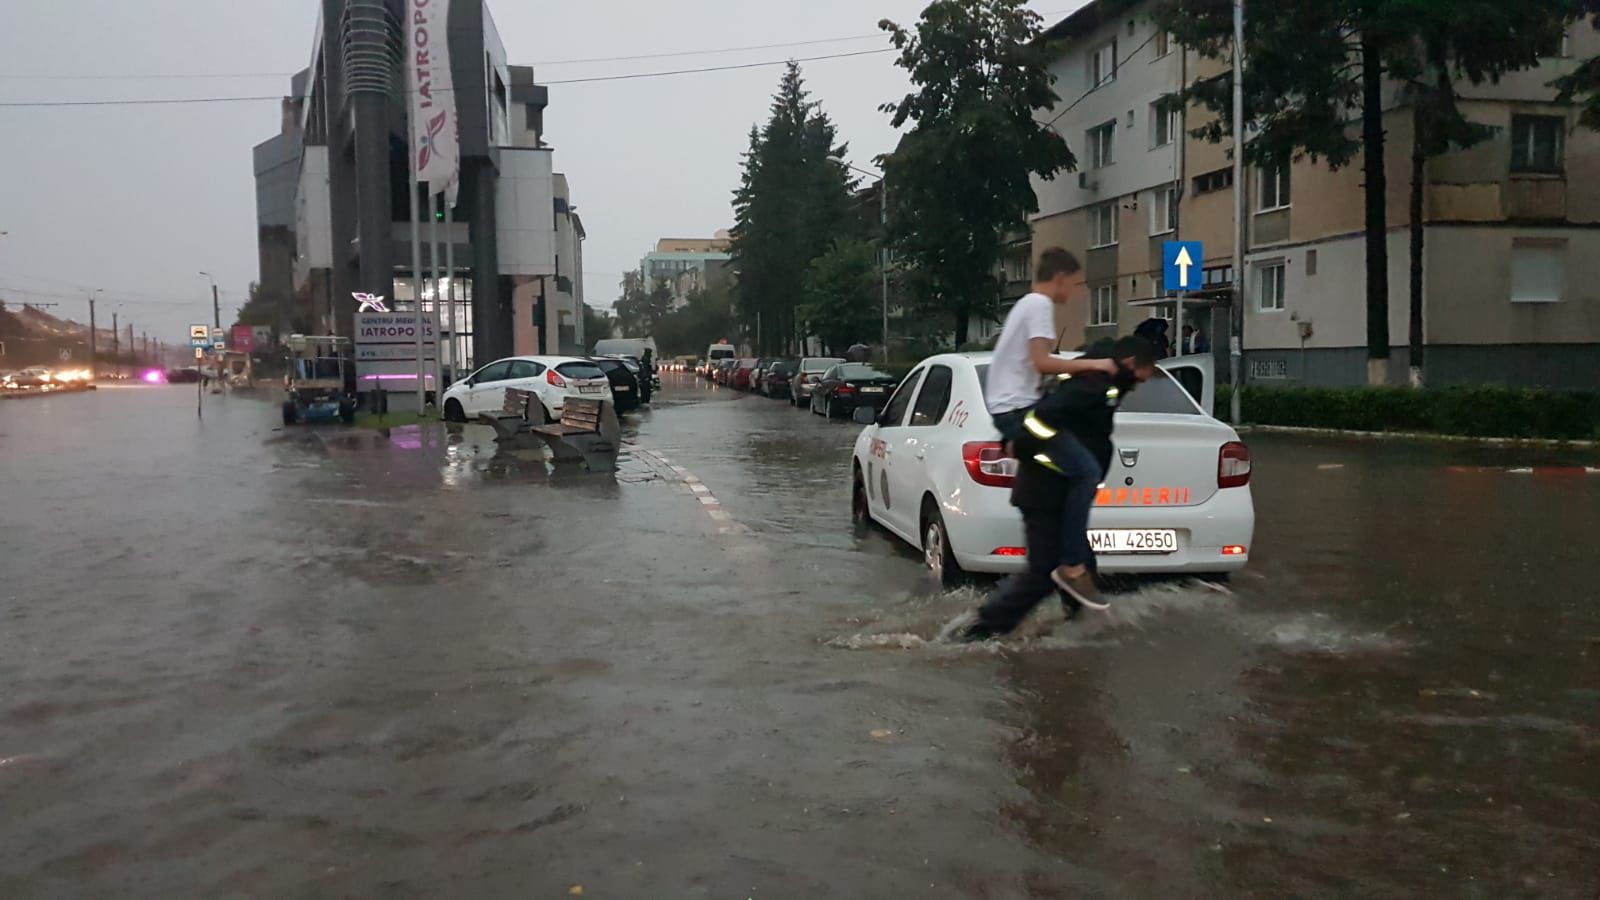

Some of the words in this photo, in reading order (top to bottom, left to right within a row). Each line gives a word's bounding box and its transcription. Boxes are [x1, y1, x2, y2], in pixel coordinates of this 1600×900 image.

[396, 316, 431, 325] MEDIAL
[361, 327, 433, 336] IATROPOIS
[951, 409, 969, 428] 112
[1095, 487, 1189, 505] MPIERII
[1091, 533, 1116, 548] MAI
[1126, 532, 1173, 548] 42650
